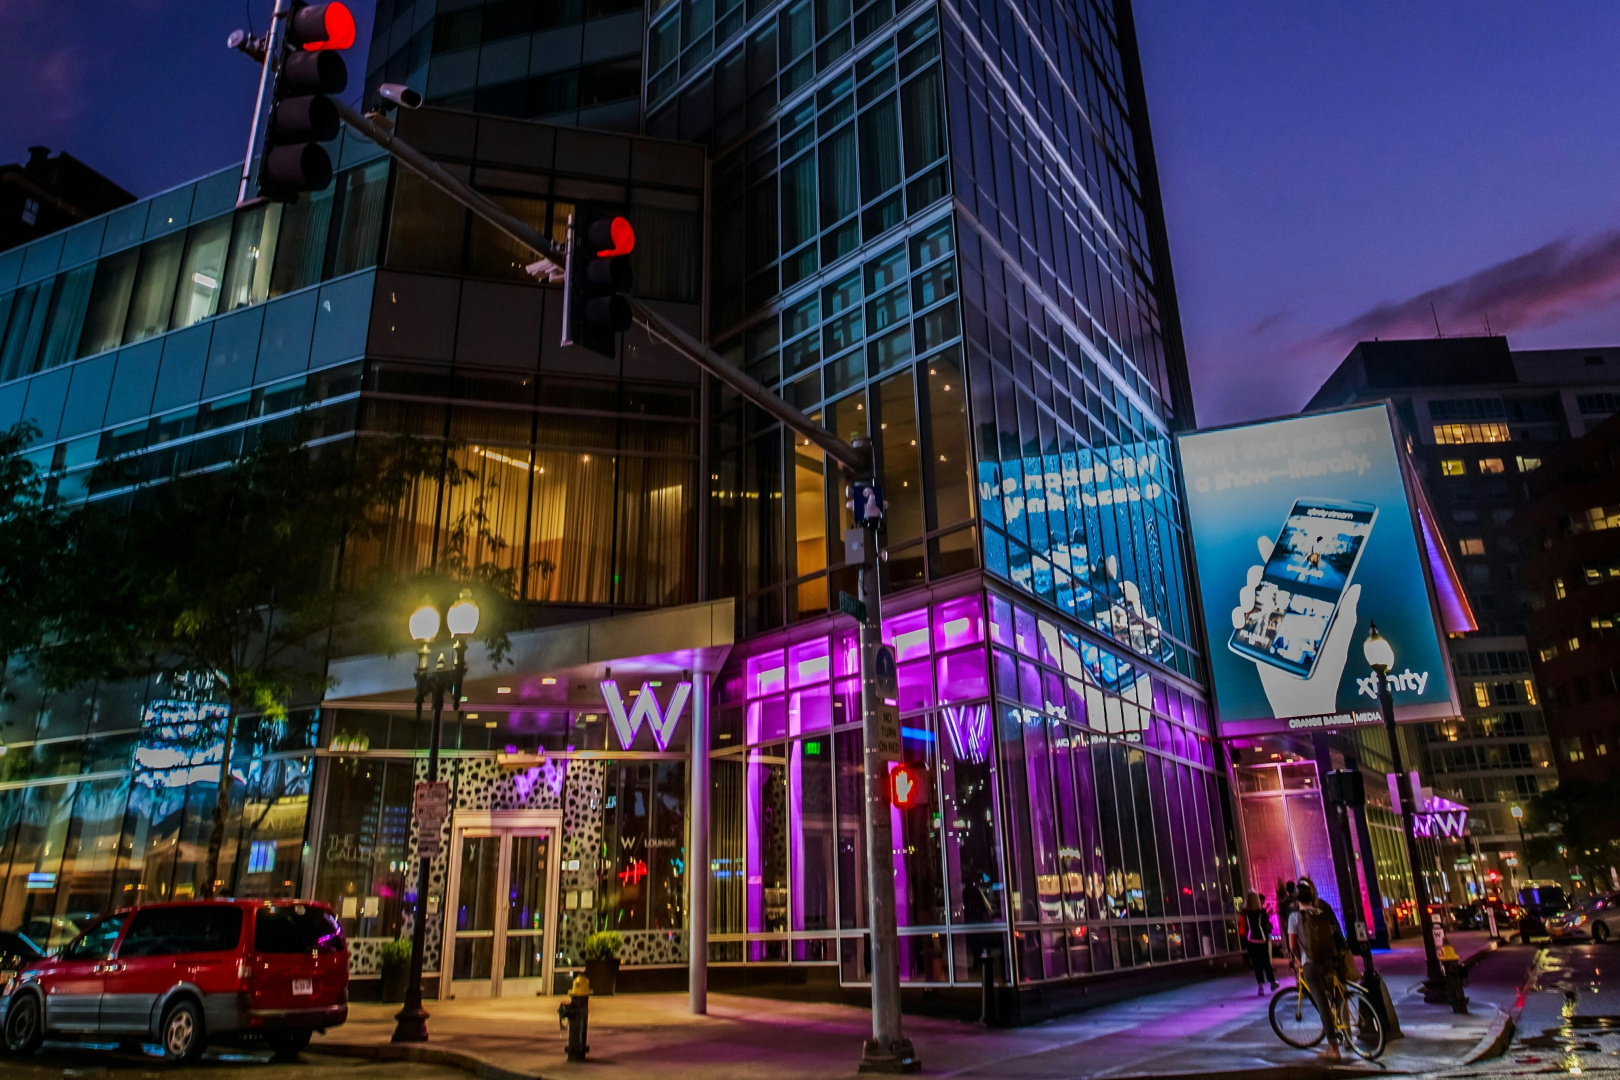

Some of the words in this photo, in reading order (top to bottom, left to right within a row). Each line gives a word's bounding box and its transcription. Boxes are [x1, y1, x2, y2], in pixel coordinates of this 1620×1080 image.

[1240, 436, 1289, 460] that
[1293, 430, 1342, 457] puts
[1346, 427, 1376, 444] on
[1195, 477, 1210, 492] a
[1357, 669, 1428, 699] xfnity
[601, 680, 692, 751] W
[883, 711, 892, 724] NO
[1355, 711, 1381, 722] MEDIA
[881, 725, 897, 738] TURN
[880, 740, 888, 753] ON
[889, 741, 900, 754] RED
[1434, 812, 1466, 837] W
[328, 833, 355, 848] THE
[620, 836, 636, 850] W
[644, 838, 677, 848] LOUNGE
